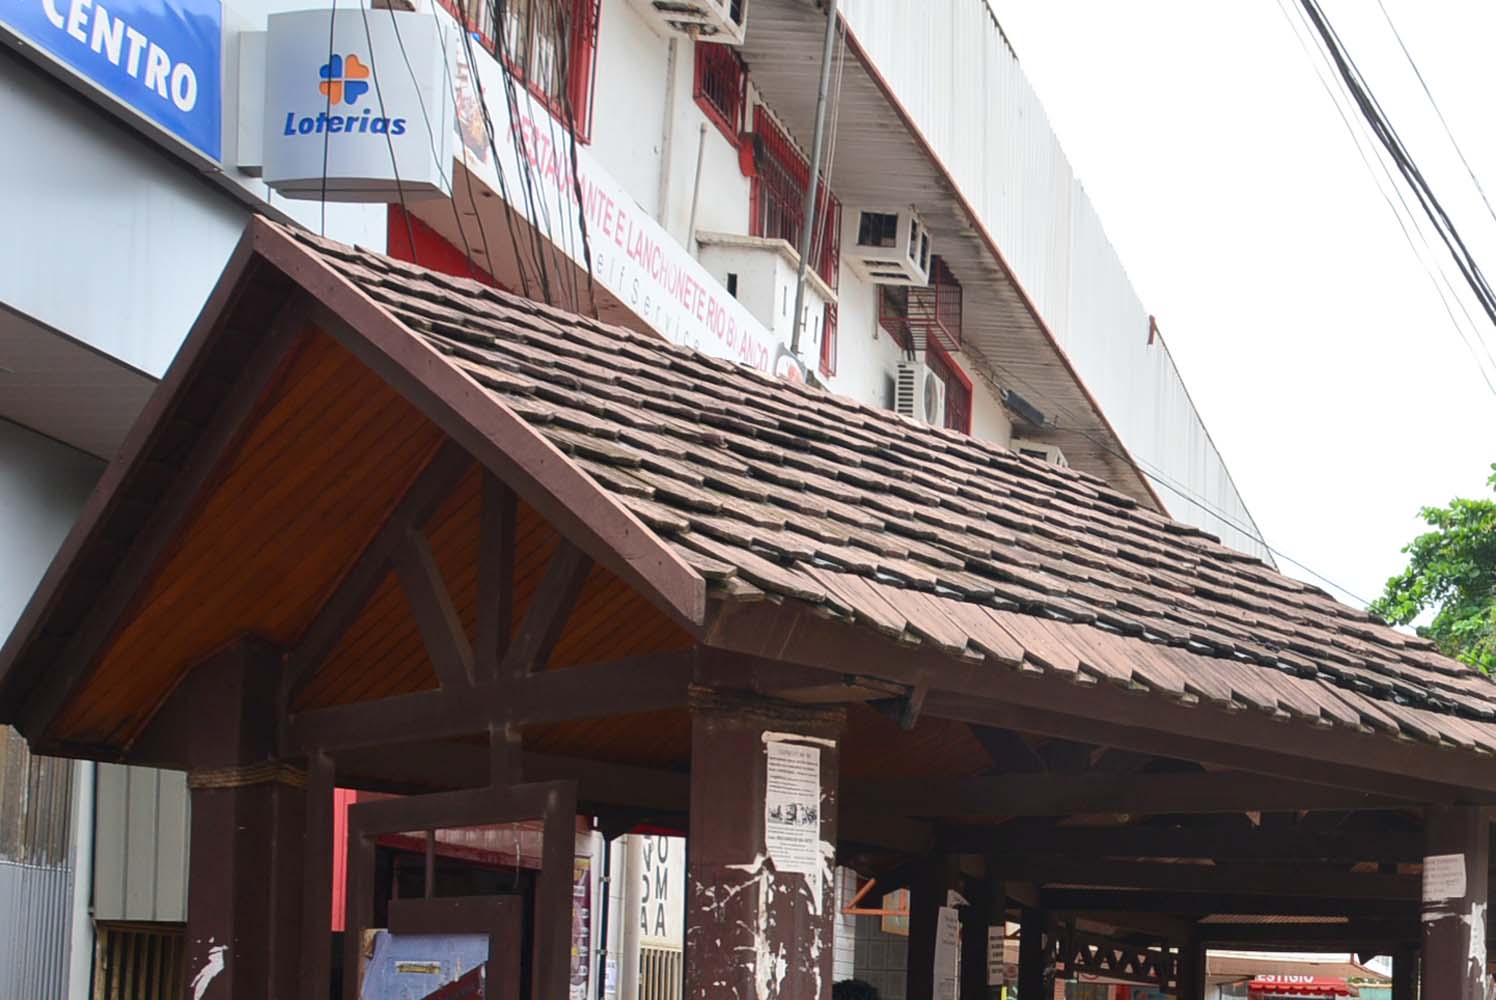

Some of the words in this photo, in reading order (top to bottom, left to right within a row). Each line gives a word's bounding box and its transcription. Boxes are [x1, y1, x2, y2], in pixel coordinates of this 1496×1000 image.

[42, 0, 198, 112] CENTRO
[283, 108, 407, 136] Loterias
[614, 209, 626, 249] E
[706, 295, 726, 341] RIO
